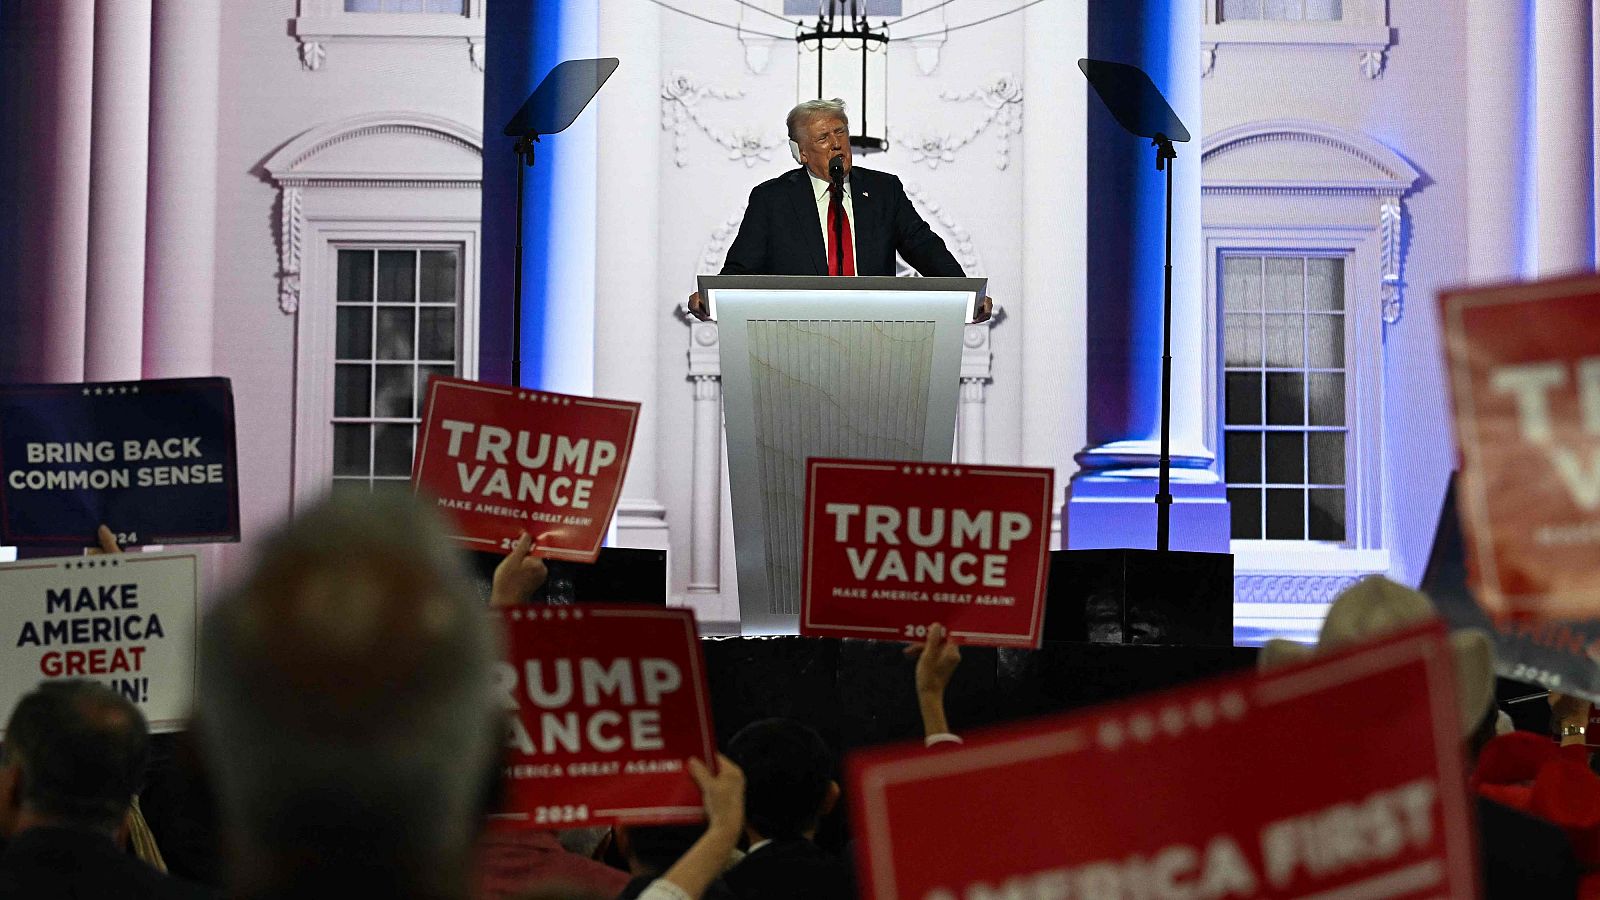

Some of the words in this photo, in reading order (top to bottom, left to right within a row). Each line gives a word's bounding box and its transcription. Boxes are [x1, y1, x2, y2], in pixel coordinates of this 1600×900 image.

[27, 441, 115, 464] BRING
[123, 437, 202, 461] BACK
[441, 419, 617, 477] TRUMP
[8, 469, 130, 490] COMMON
[137, 464, 224, 487] SENSE
[457, 461, 594, 510] VANCE
[438, 497, 472, 511] MAKE
[475, 503, 528, 519] AMERICA
[532, 512, 562, 524] GREAT
[825, 502, 1033, 551] TRUMP
[846, 547, 1009, 588] VANCE
[46, 584, 139, 614] MAKE
[832, 587, 867, 599] MAKE
[871, 588, 929, 602] AMERICA
[933, 592, 972, 604] GREAT
[974, 594, 1016, 607] AGAIN!
[17, 613, 165, 647] AMERICA
[904, 624, 947, 638] 20
[40, 647, 146, 677] GREAT
[1514, 663, 1562, 688] 2024
[488, 657, 682, 709] RUMP
[507, 709, 665, 757] ANCE
[567, 761, 621, 777] GREAT
[625, 759, 683, 775] AGAIN!
[534, 804, 590, 824] 2024
[1258, 778, 1438, 889] FIRST
